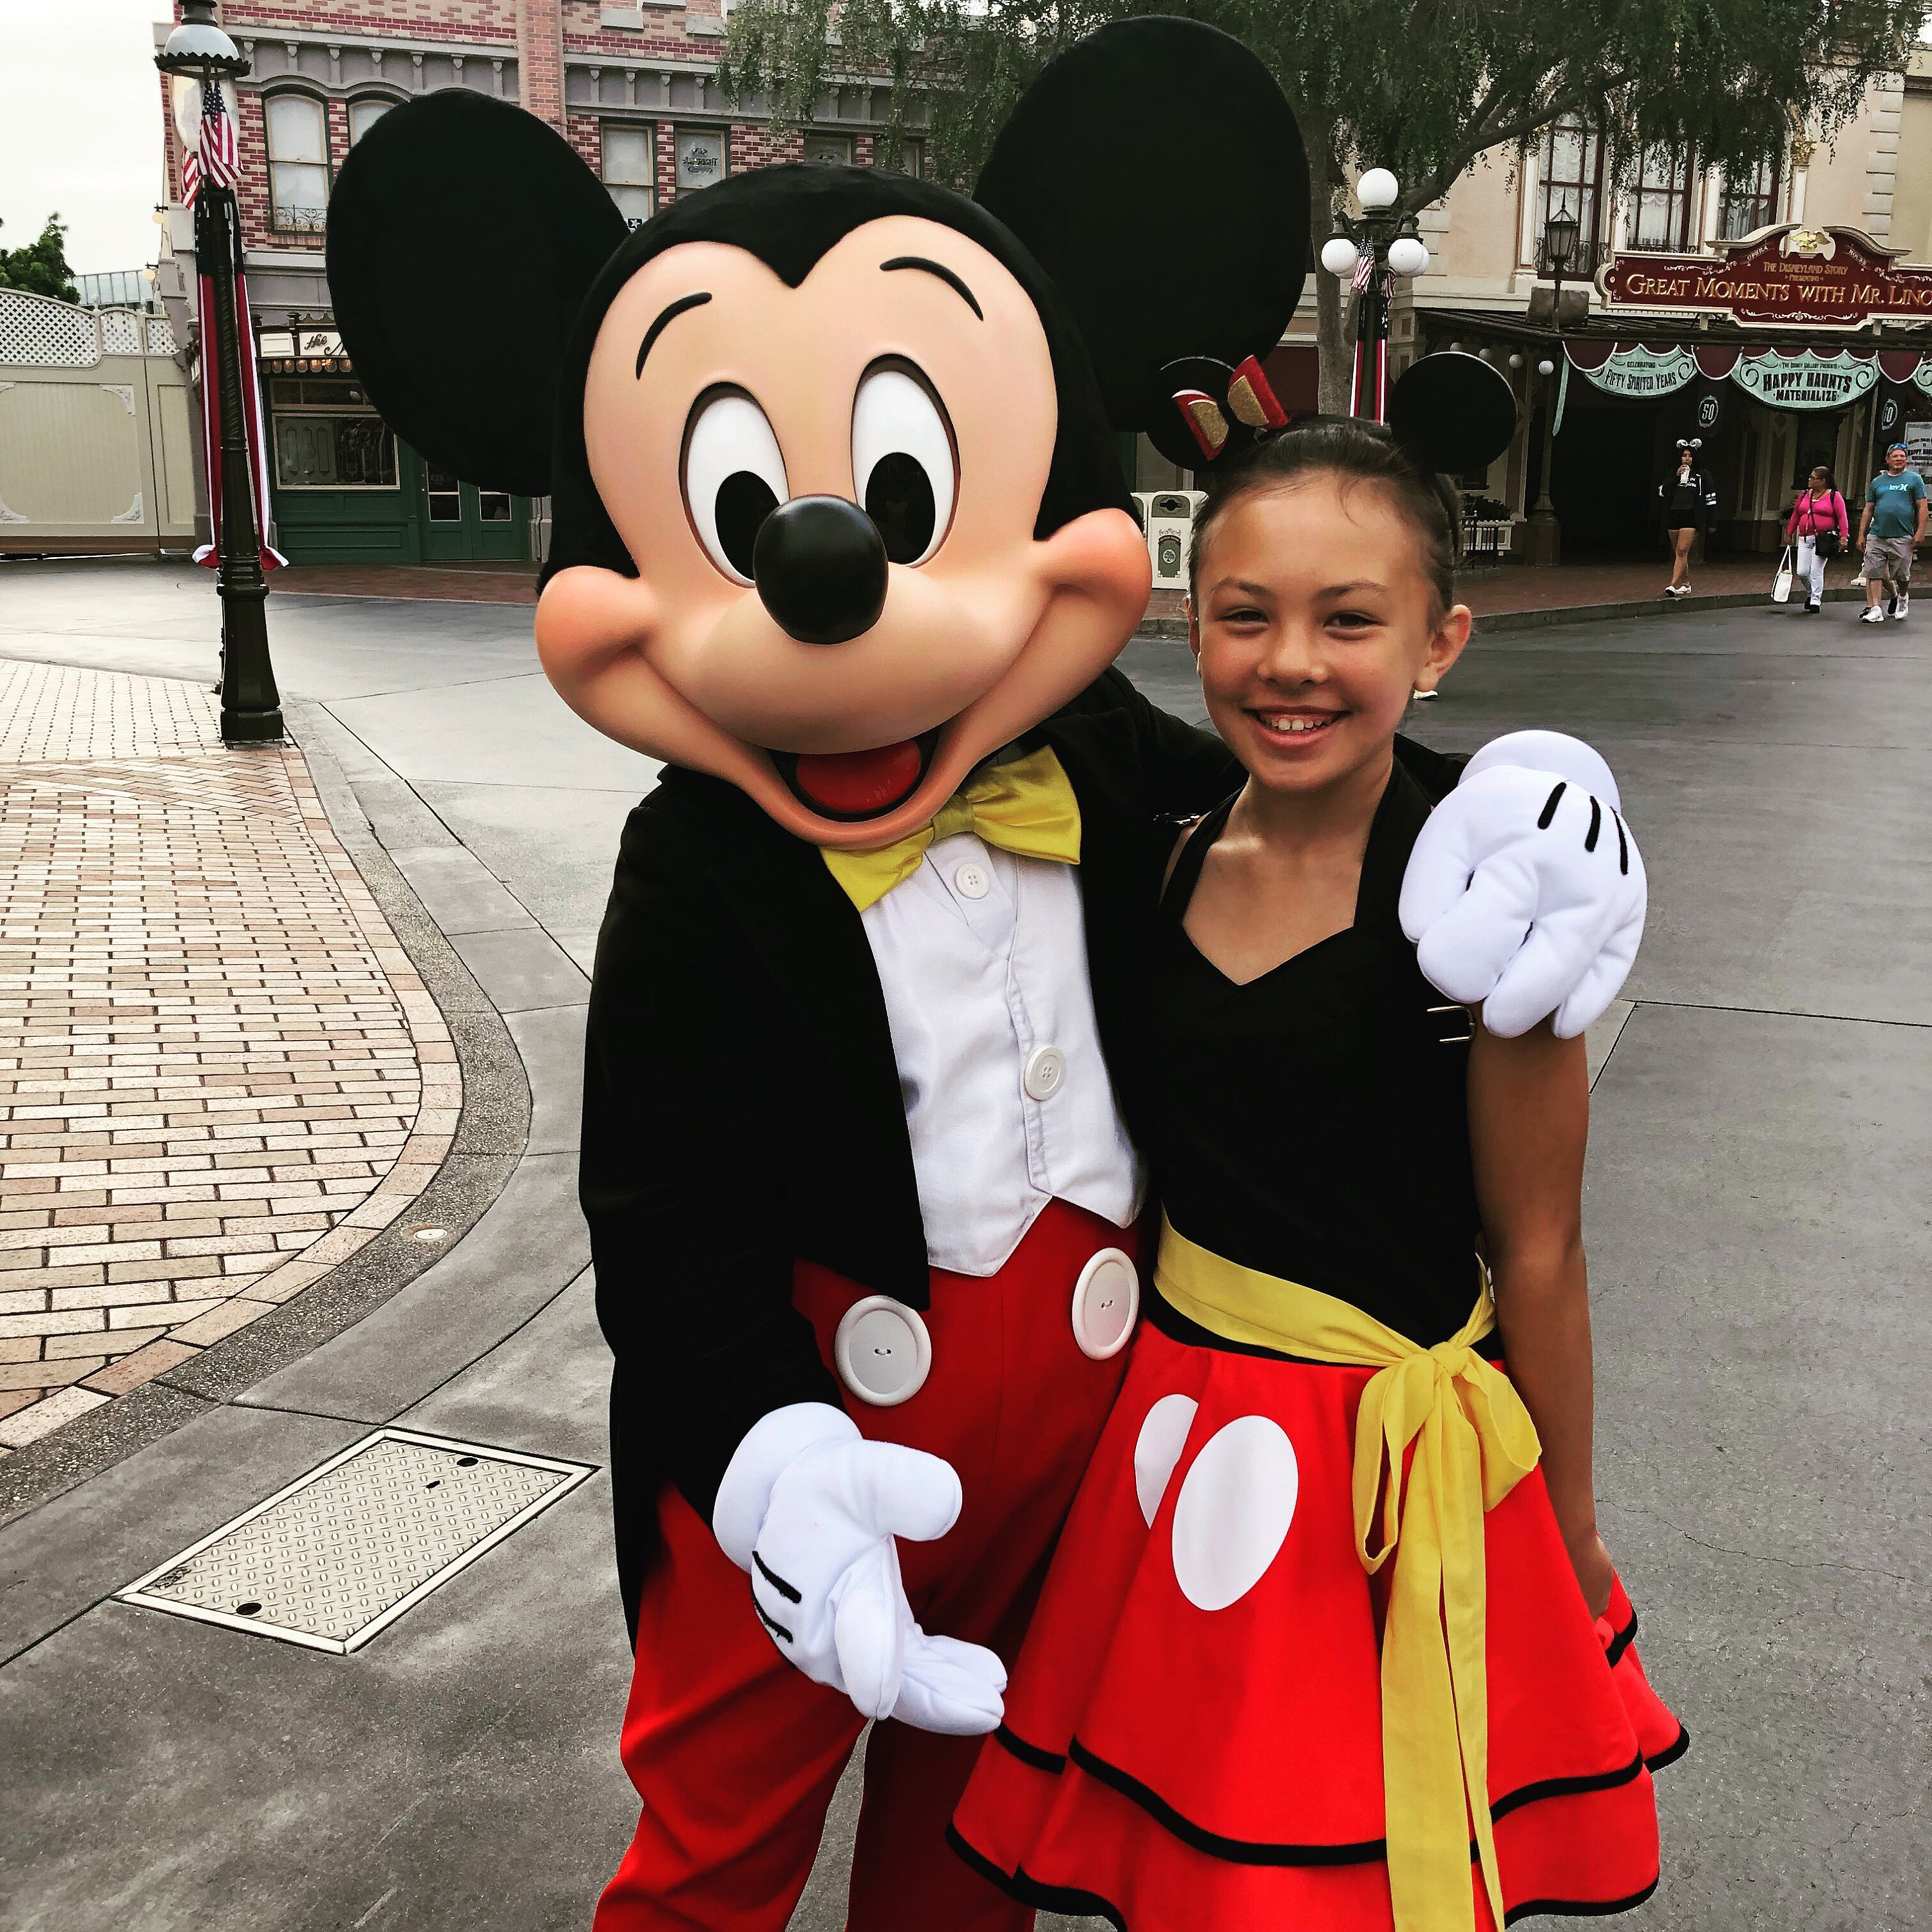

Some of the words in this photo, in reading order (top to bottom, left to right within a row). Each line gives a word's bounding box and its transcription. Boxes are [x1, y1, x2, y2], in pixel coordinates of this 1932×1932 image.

[1747, 245, 1768, 260] OPERA
[1848, 249, 1868, 267] HOUSE
[1763, 261, 1777, 272] THE
[1779, 262, 1823, 274] DISNEYLAND
[1824, 264, 1849, 275] STORY
[1625, 274, 1690, 297] GREAT
[1694, 277, 1790, 301] MOMENTS
[1797, 285, 1846, 303] WITH
[1850, 283, 1884, 305] MR.
[304, 334, 328, 350] the
[1604, 368, 1626, 388] FIFTY
[1627, 374, 1653, 390] SPIRITED
[1655, 372, 1677, 390] YEARS
[1763, 372, 1803, 392] HAPPY
[1806, 372, 1853, 393] HAUNTS
[1702, 404, 1714, 420] 50
